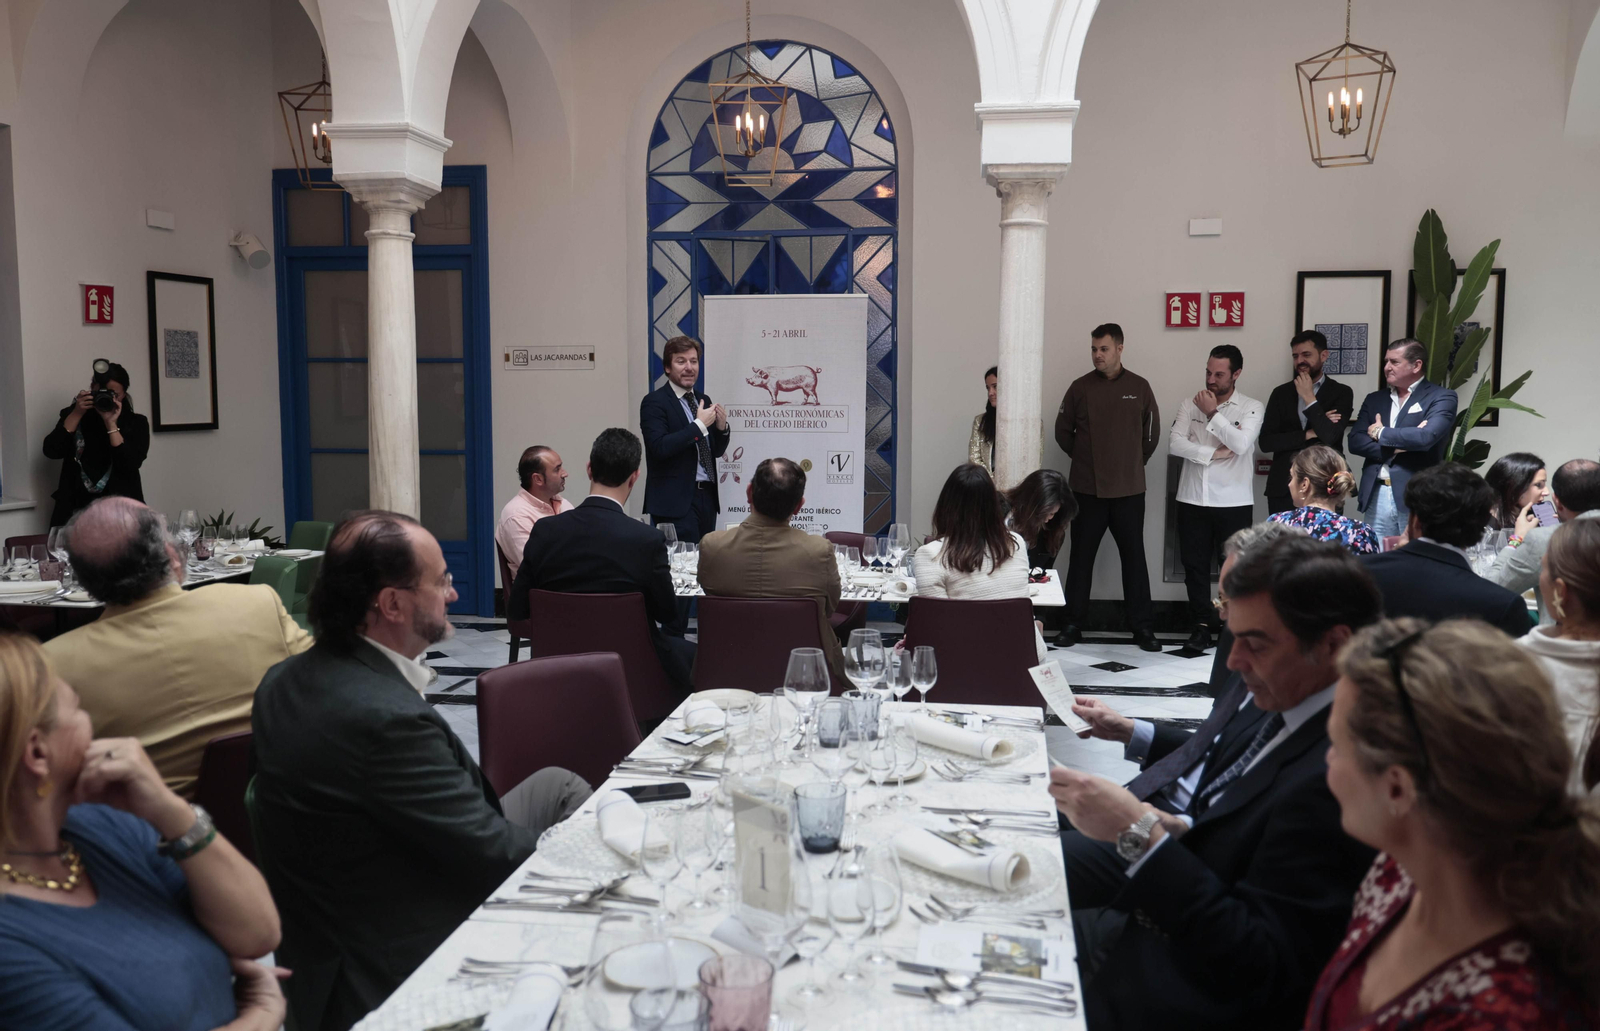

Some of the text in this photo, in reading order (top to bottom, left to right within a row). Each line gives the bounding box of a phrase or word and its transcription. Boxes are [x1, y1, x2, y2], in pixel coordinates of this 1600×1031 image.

[781, 329, 808, 338] ABRIL
[544, 353, 587, 361] JACARANDAS
[728, 408, 845, 418] JORNADAS GASTRONÓMICAS
[744, 418, 828, 429] DEL CERDO IBÉRICO
[727, 505, 746, 513] MENÚ
[815, 506, 841, 515] IBÉRICO
